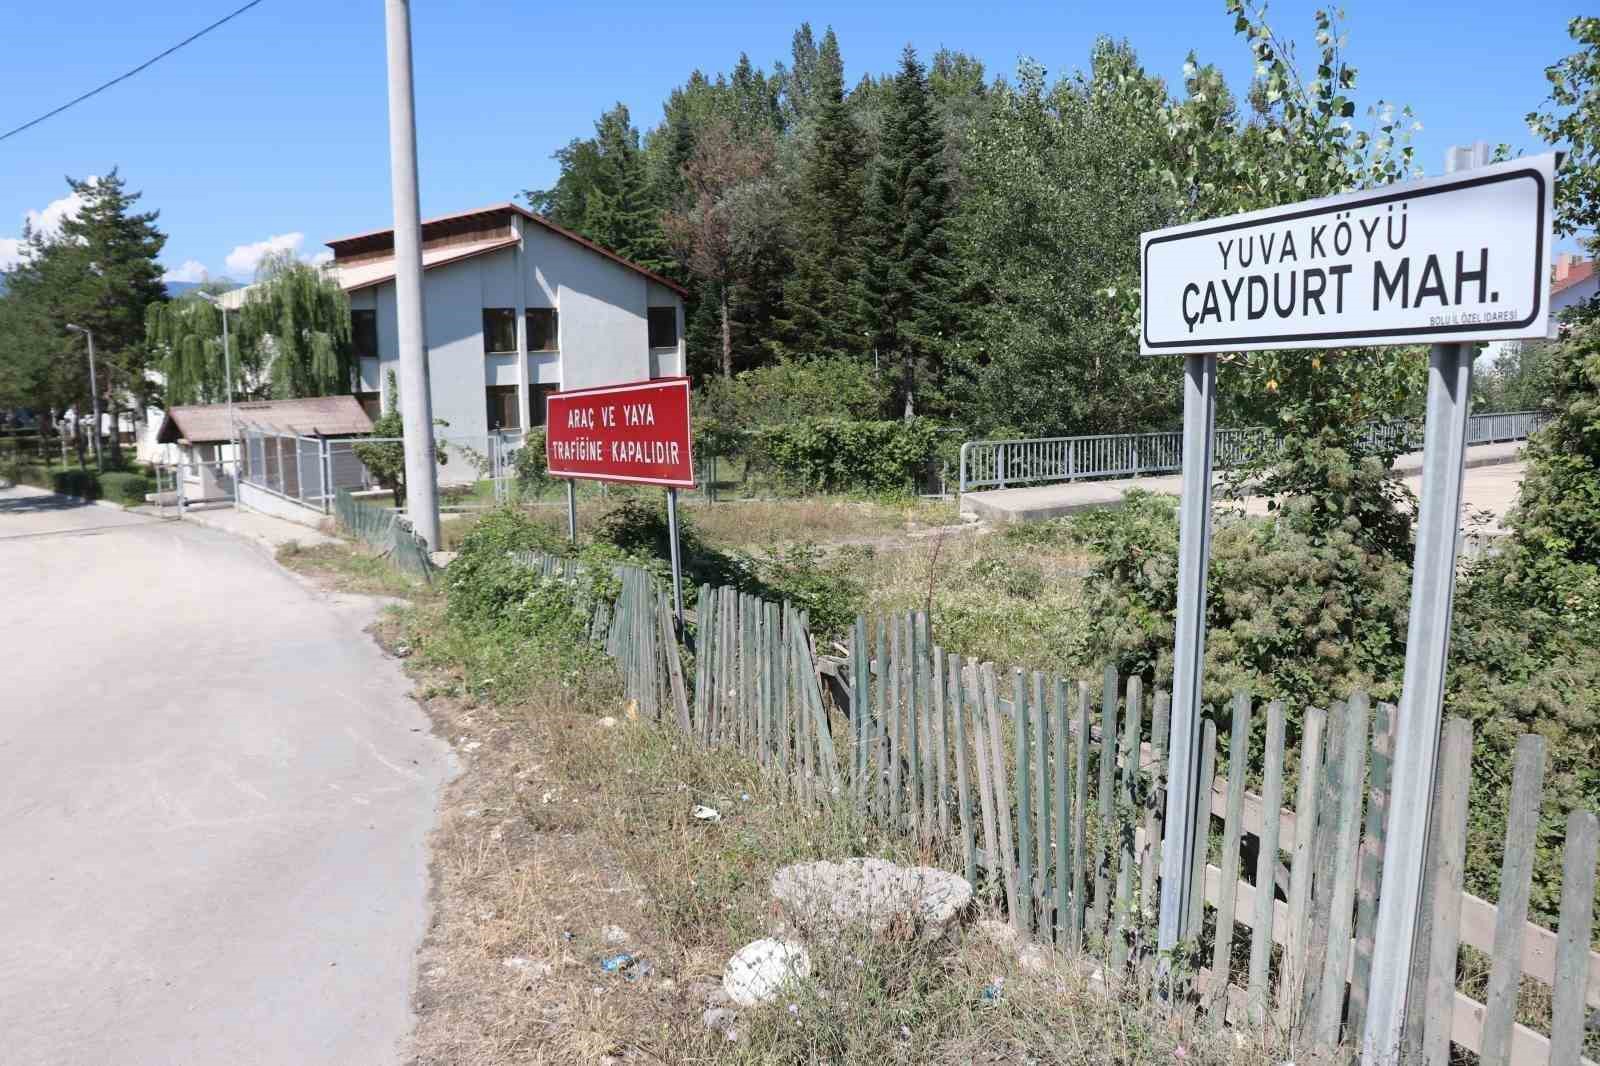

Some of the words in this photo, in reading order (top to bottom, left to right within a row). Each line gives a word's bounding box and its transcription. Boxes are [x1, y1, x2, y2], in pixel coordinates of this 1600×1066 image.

[1217, 230, 1297, 270] YUVA
[1310, 203, 1408, 258] KÖYÜ
[1182, 264, 1353, 332] ÇAYDURT
[1372, 247, 1500, 311] MAH.
[568, 408, 595, 430] ARAÇ
[602, 405, 616, 428] VE
[623, 404, 655, 426] YAYA
[553, 437, 603, 461] TRAFİĞİNE
[612, 441, 679, 464] KAPALIDIR
